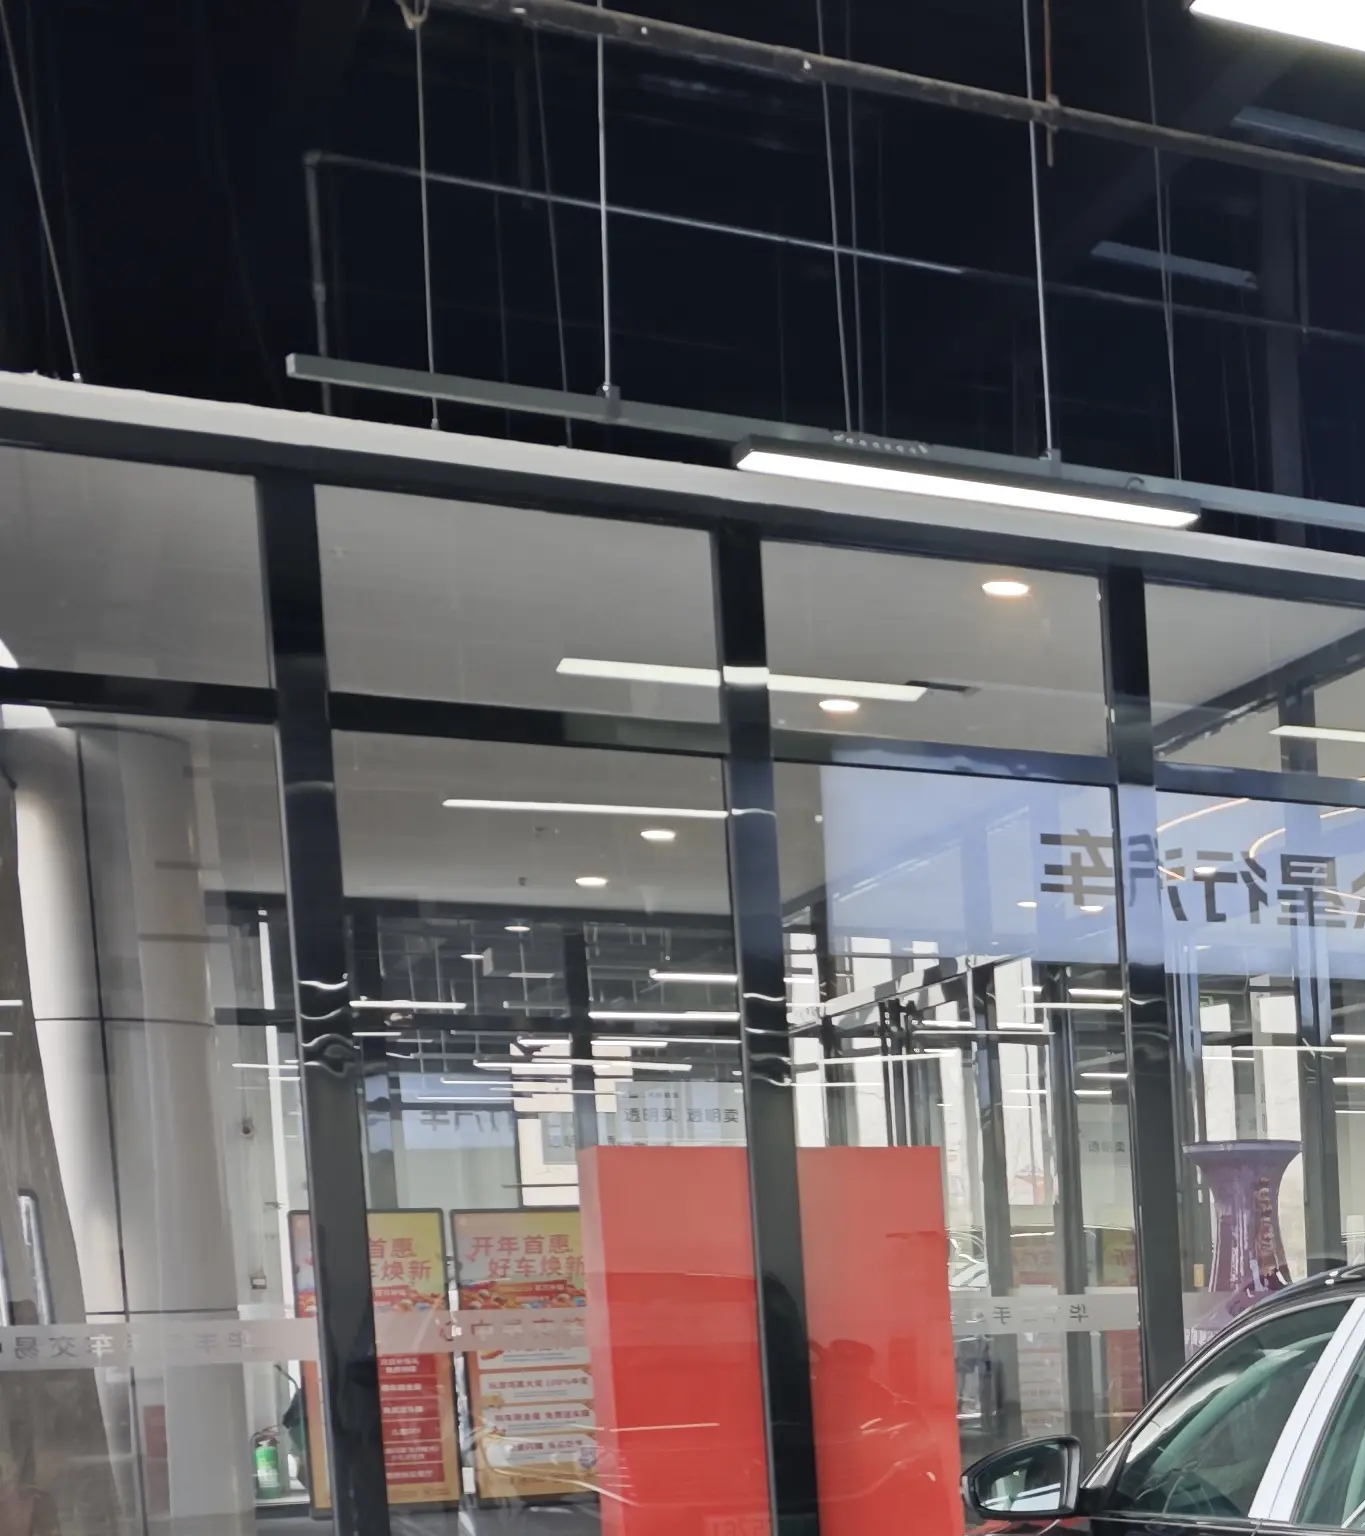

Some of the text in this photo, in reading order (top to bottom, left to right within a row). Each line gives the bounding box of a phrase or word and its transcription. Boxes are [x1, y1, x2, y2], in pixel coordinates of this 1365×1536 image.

[370, 1237, 417, 1259] 首惠
[472, 1234, 574, 1255] 开年首惠
